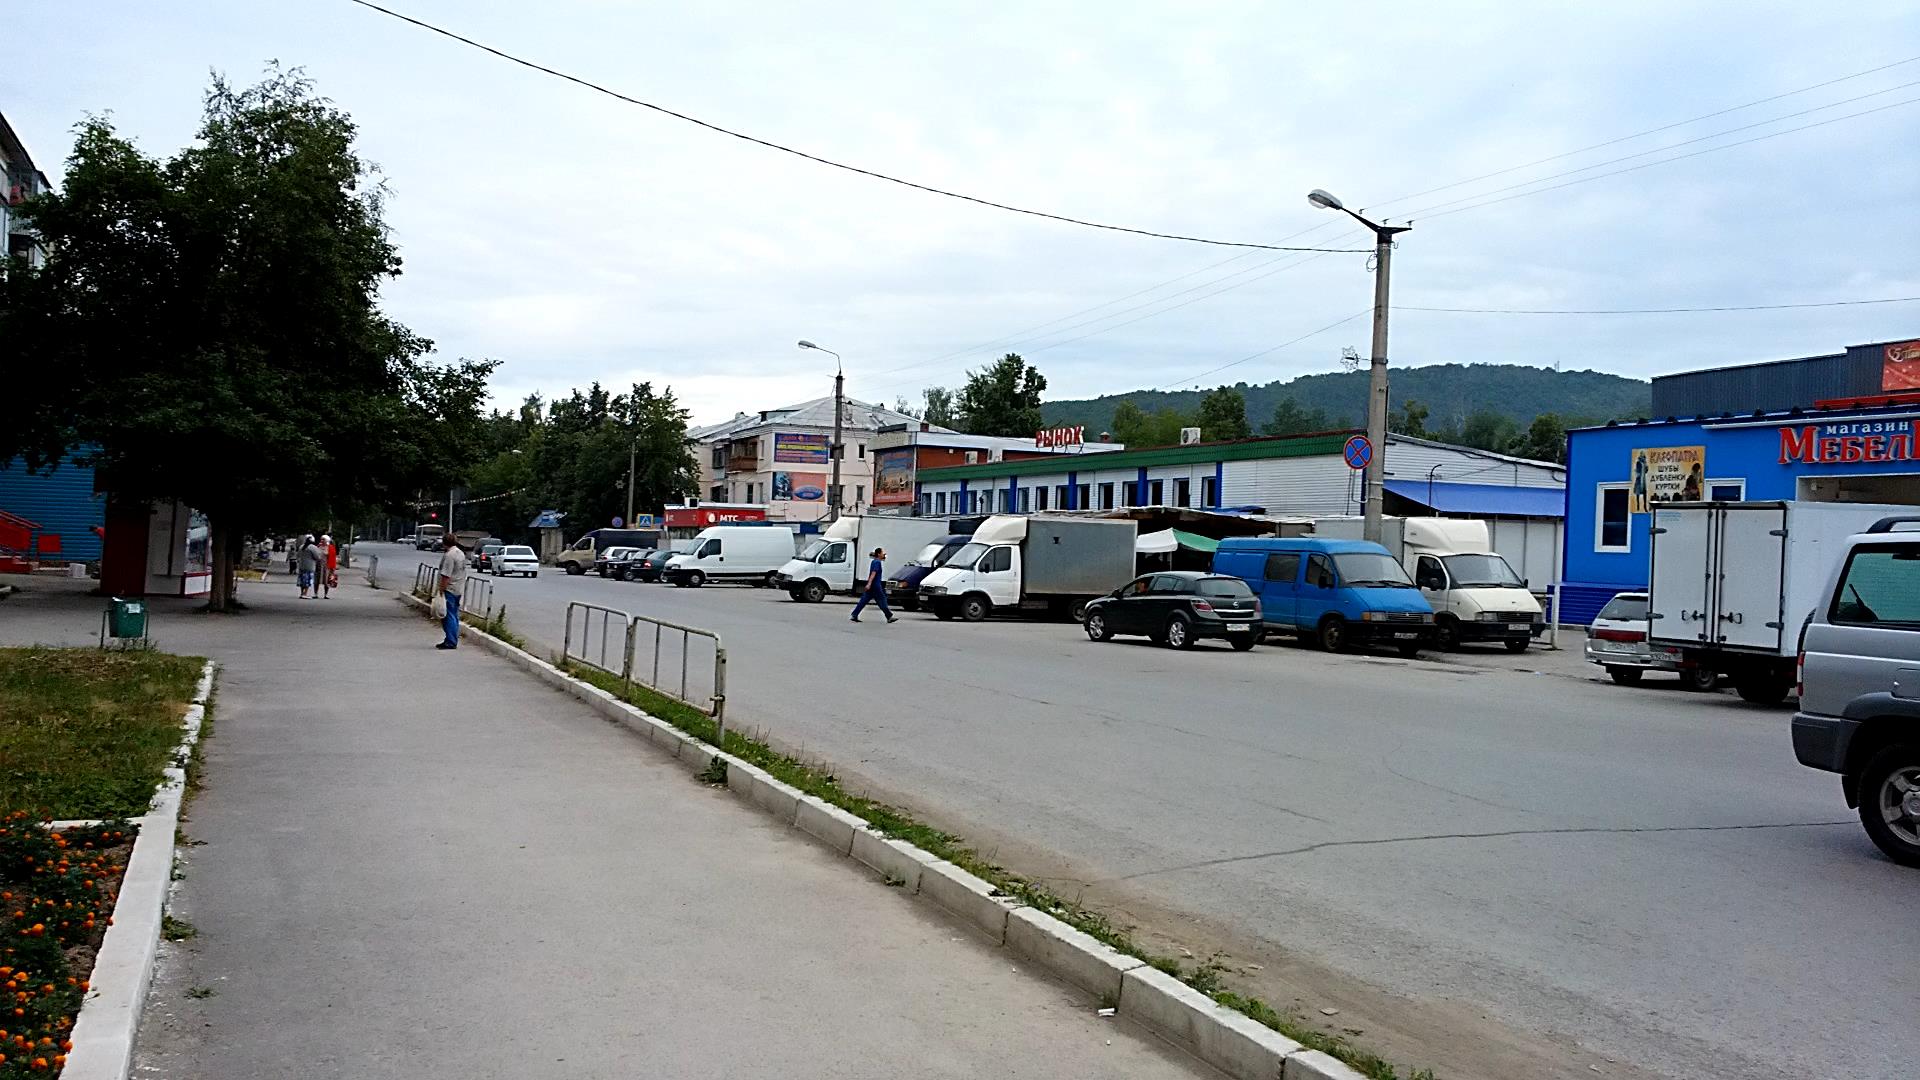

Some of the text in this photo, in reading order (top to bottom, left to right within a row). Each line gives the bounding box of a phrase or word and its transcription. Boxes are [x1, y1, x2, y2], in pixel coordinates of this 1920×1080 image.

[1826, 421, 1909, 434] магазин
[1035, 425, 1085, 448] РЫНОК
[1657, 465, 1680, 473] ШУБЫ
[1650, 474, 1686, 482] ДУБЛЕНКИ
[720, 514, 739, 522] МТС
